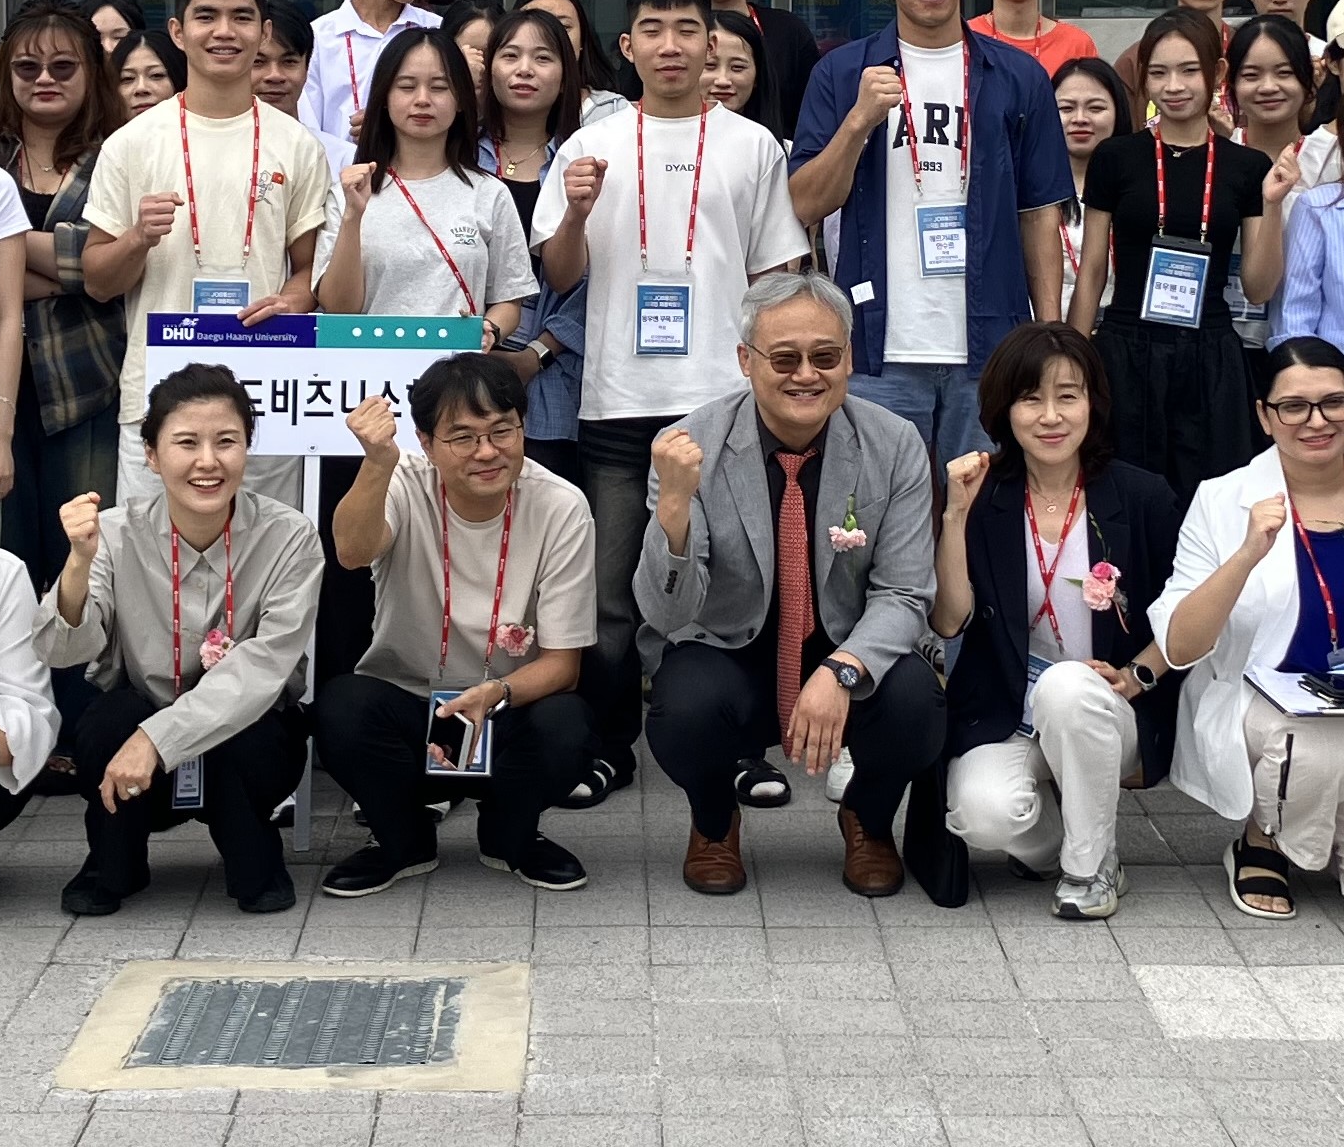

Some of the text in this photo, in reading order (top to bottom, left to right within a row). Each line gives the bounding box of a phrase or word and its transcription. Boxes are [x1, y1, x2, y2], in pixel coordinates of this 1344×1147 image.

[162, 327, 298, 343] DHU Daegu Haany University
